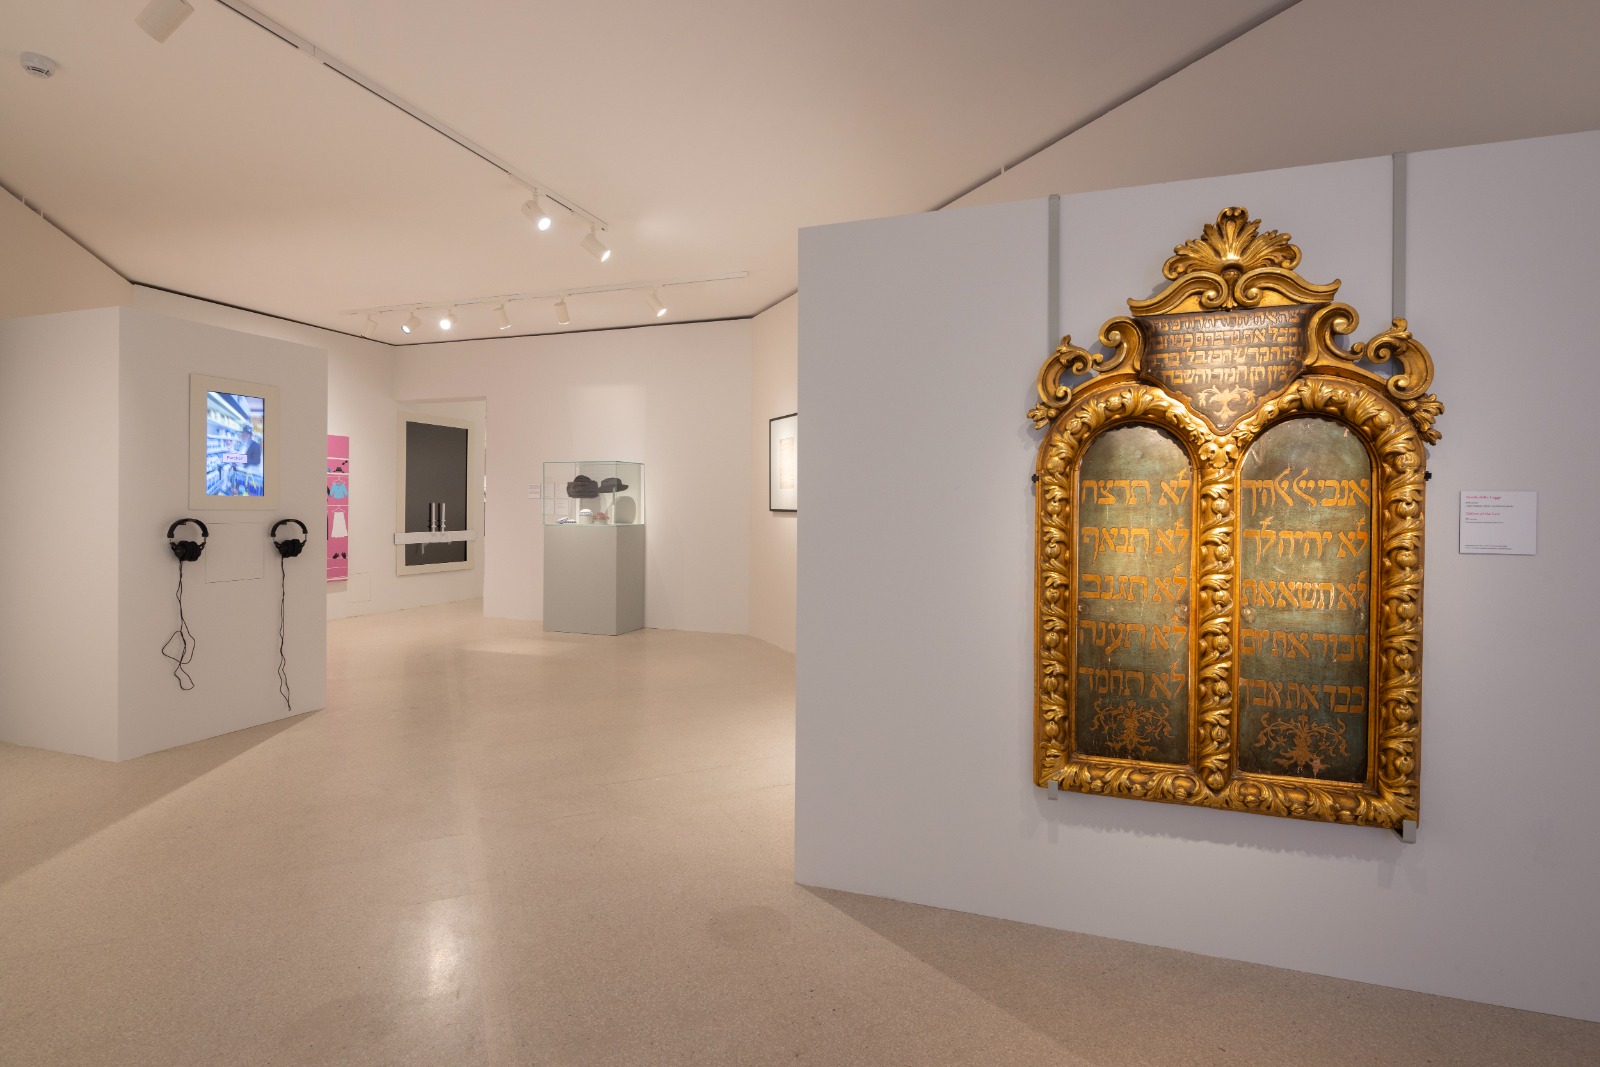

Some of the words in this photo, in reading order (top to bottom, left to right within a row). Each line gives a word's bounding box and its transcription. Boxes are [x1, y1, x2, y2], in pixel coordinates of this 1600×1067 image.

[1242, 328, 1267, 344] את
[1081, 479, 1151, 506] תרצח
[1158, 467, 1190, 506] לא
[1317, 478, 1370, 507] אנכי
[1081, 526, 1150, 565] תנאף
[1154, 517, 1190, 554] לא
[1243, 516, 1276, 564] לך
[1278, 529, 1333, 559] יהיה
[1337, 515, 1368, 558] לא
[1078, 572, 1148, 602] תגנב
[1152, 562, 1188, 602] לא
[1241, 579, 1276, 608] את
[1276, 581, 1335, 610] תשא
[1337, 570, 1367, 609] לא
[1079, 619, 1146, 655] תענה
[1149, 614, 1188, 651] לא
[1241, 628, 1270, 656] יום
[1271, 631, 1311, 660] את
[1312, 632, 1366, 662] זכור
[1078, 665, 1145, 697] תחמד
[1149, 660, 1186, 699] לא
[1239, 677, 1283, 710] אביך
[1285, 682, 1320, 710] את
[1322, 685, 1366, 713] כבד
